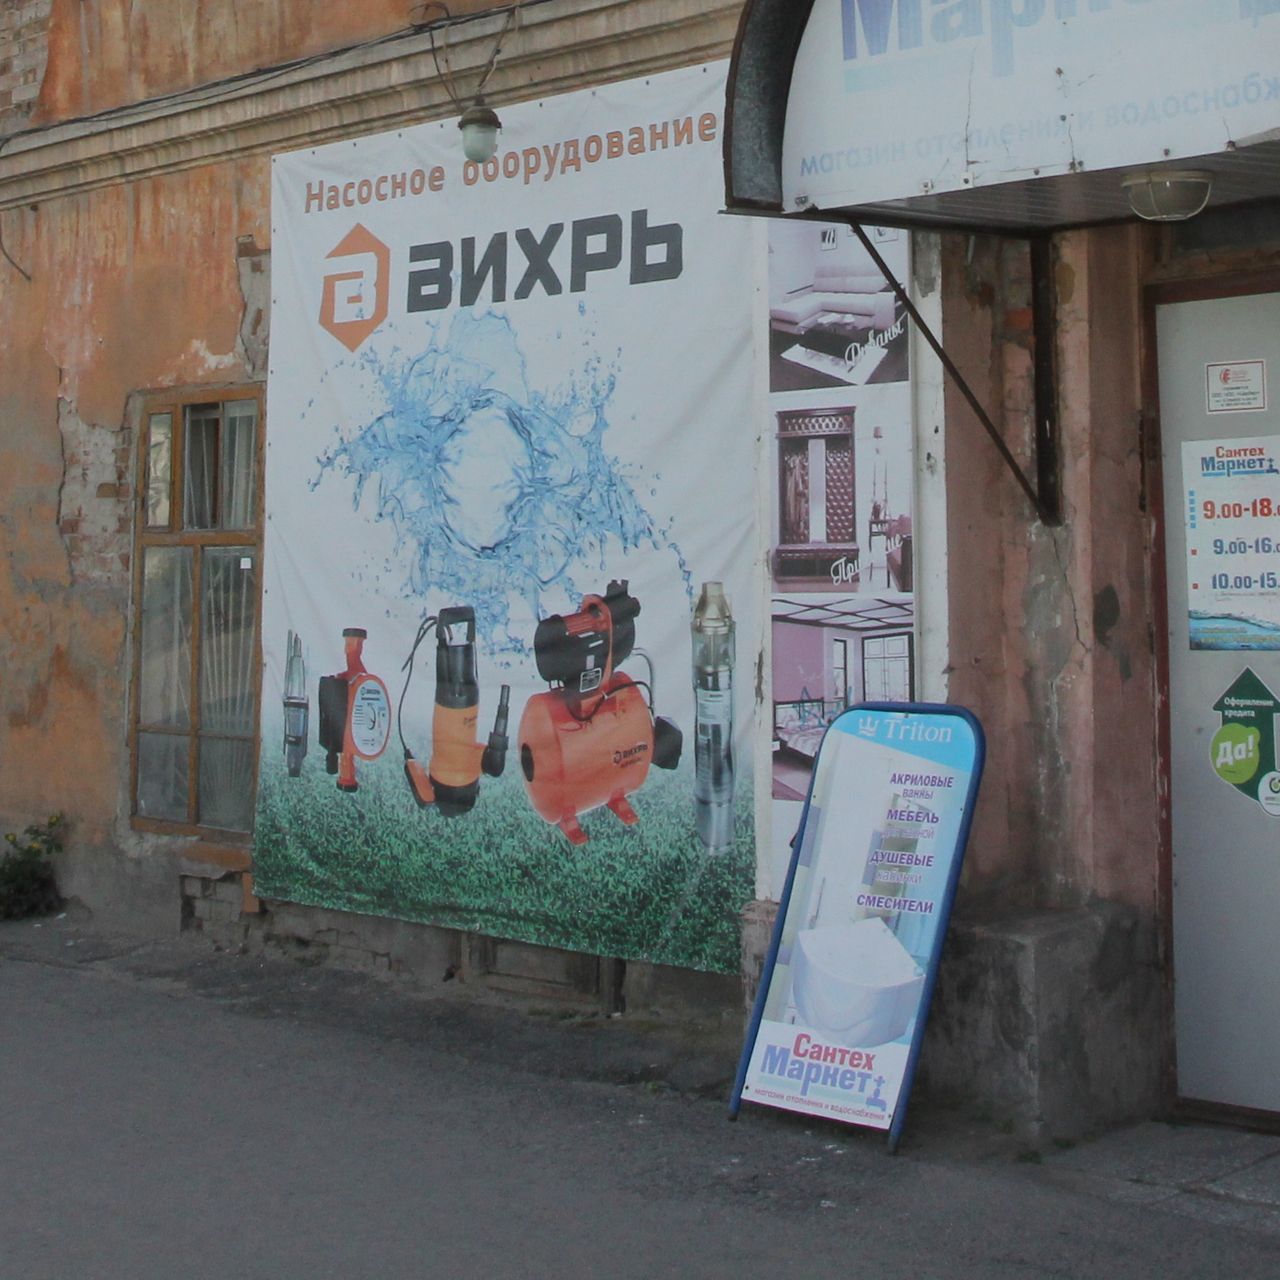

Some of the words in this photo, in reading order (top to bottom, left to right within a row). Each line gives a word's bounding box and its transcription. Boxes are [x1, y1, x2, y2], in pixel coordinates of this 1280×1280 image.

[800, 142, 906, 176] магазин
[915, 117, 1067, 159] отопления
[304, 166, 446, 213] Насосное
[462, 111, 718, 185] оборудование
[406, 209, 683, 312] ВИХРЬ
[1216, 446, 1265, 458] Сантех
[1201, 456, 1265, 477] Маркет
[884, 718, 953, 743] Triton
[1216, 734, 1255, 768] Да!
[889, 773, 955, 789] АКРИЛОВЫЕ
[902, 788, 934, 800] ванны
[886, 809, 939, 824] МЕБЕЛЬ
[870, 851, 935, 867] ДУШЕВЫЕ
[856, 894, 934, 913] СМЕСИТЕЛИ
[793, 1033, 876, 1071] Сантех
[760, 1044, 872, 1097] Маркет
[754, 1088, 785, 1100] магазин
[786, 1094, 824, 1109] отопления
